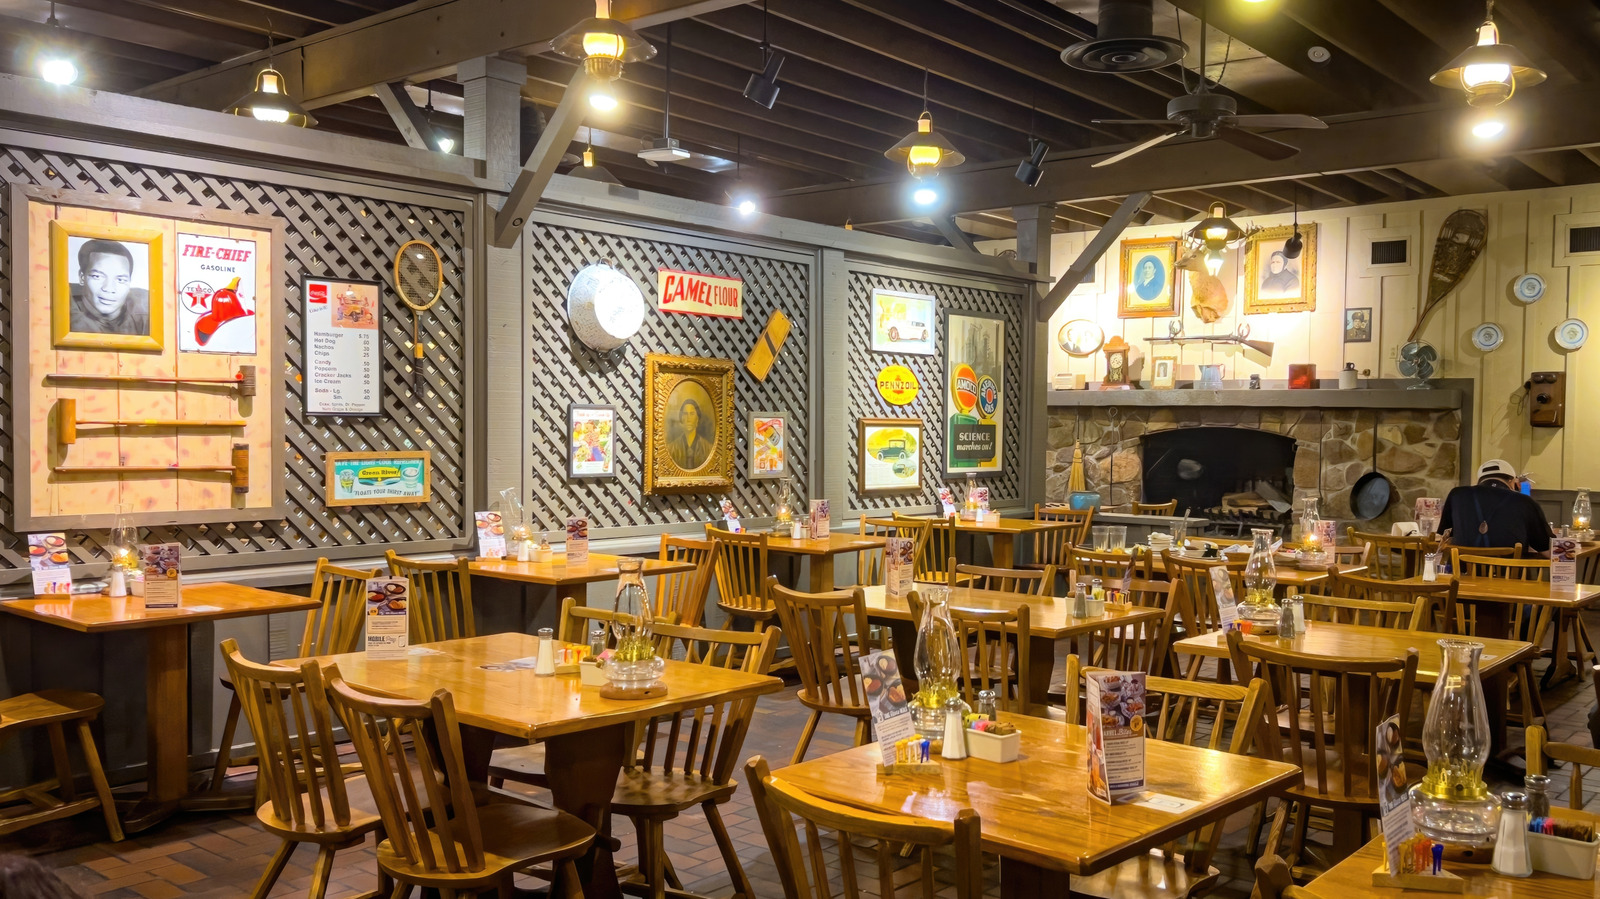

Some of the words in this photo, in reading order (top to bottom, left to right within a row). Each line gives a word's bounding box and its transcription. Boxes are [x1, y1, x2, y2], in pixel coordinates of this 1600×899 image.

[182, 244, 252, 262] FIRE-CHIEF
[200, 264, 236, 273] GASOLINE
[186, 286, 213, 294] TEXACO
[662, 275, 713, 307] CAMEL
[713, 285, 739, 308] FLOUR
[313, 331, 344, 339] Hamburger
[879, 381, 917, 390] PENNZOIL
[957, 377, 977, 396] AMOCO
[959, 432, 991, 441] SCIENCE
[956, 441, 981, 451] marches
